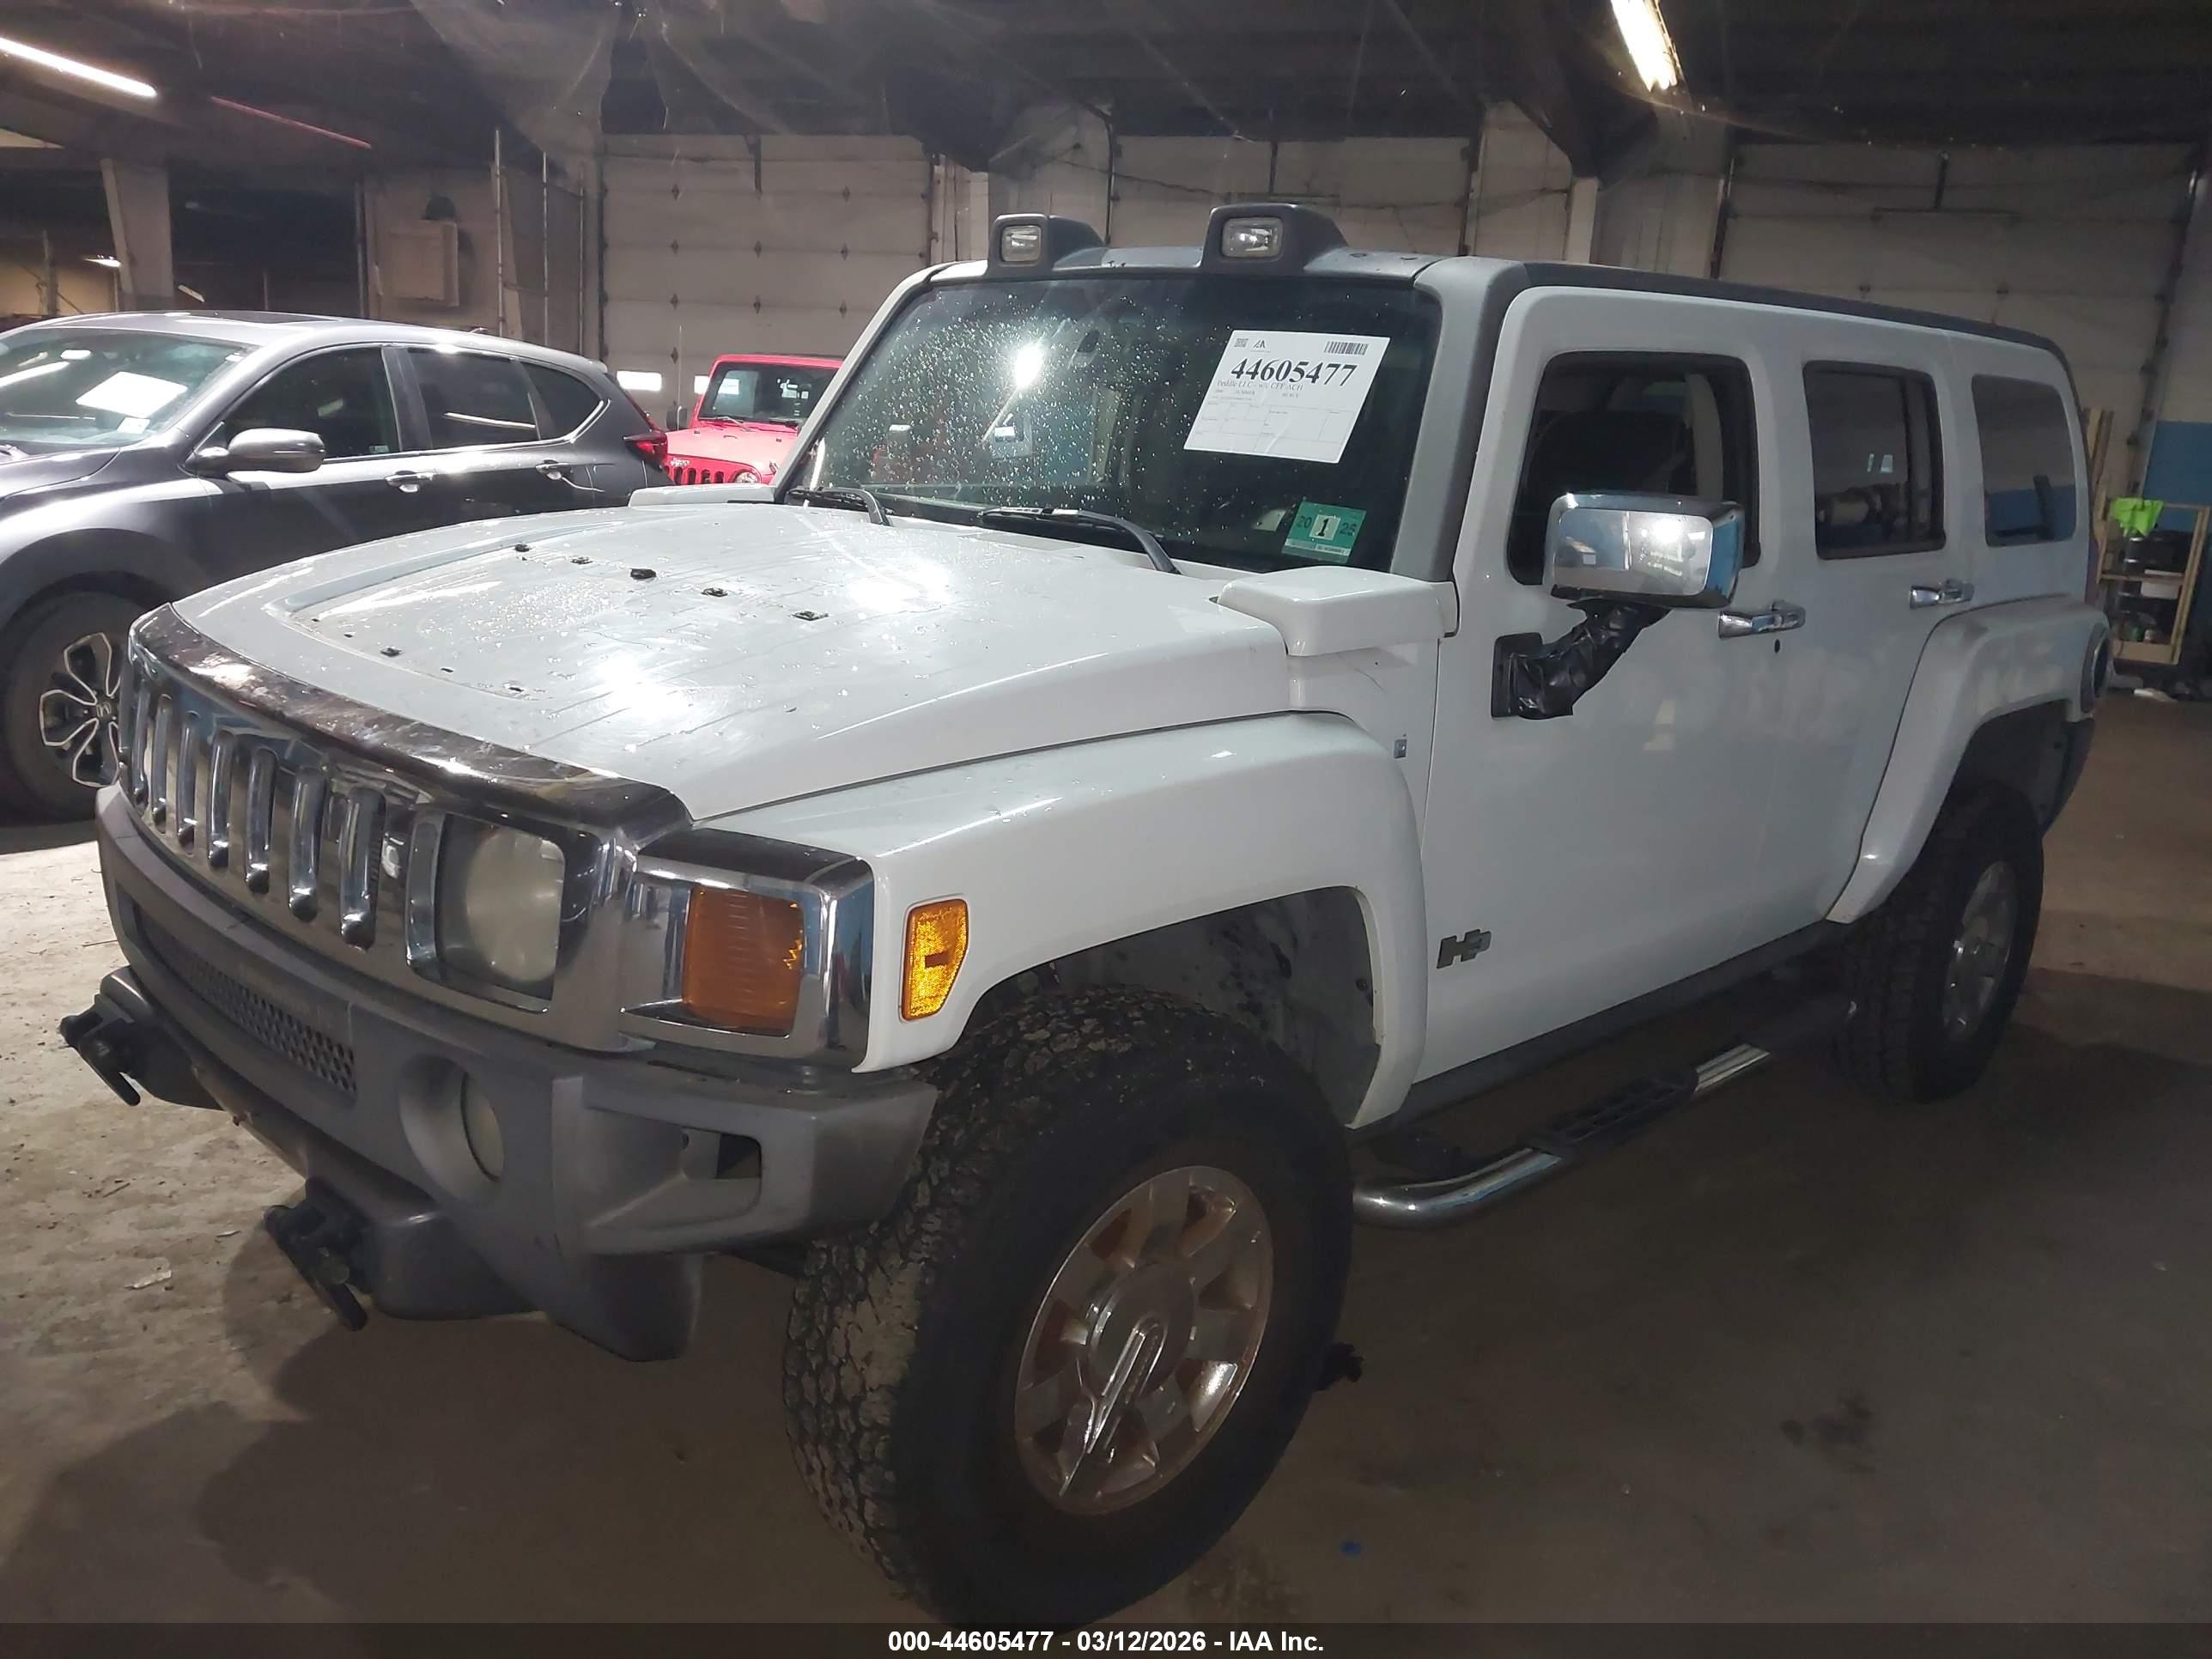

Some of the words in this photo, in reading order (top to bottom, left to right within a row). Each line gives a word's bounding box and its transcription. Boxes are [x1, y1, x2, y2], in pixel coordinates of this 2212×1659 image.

[1231, 357, 1358, 386] 44605477
[1296, 515, 1312, 528] 20
[1318, 518, 1329, 537] 1
